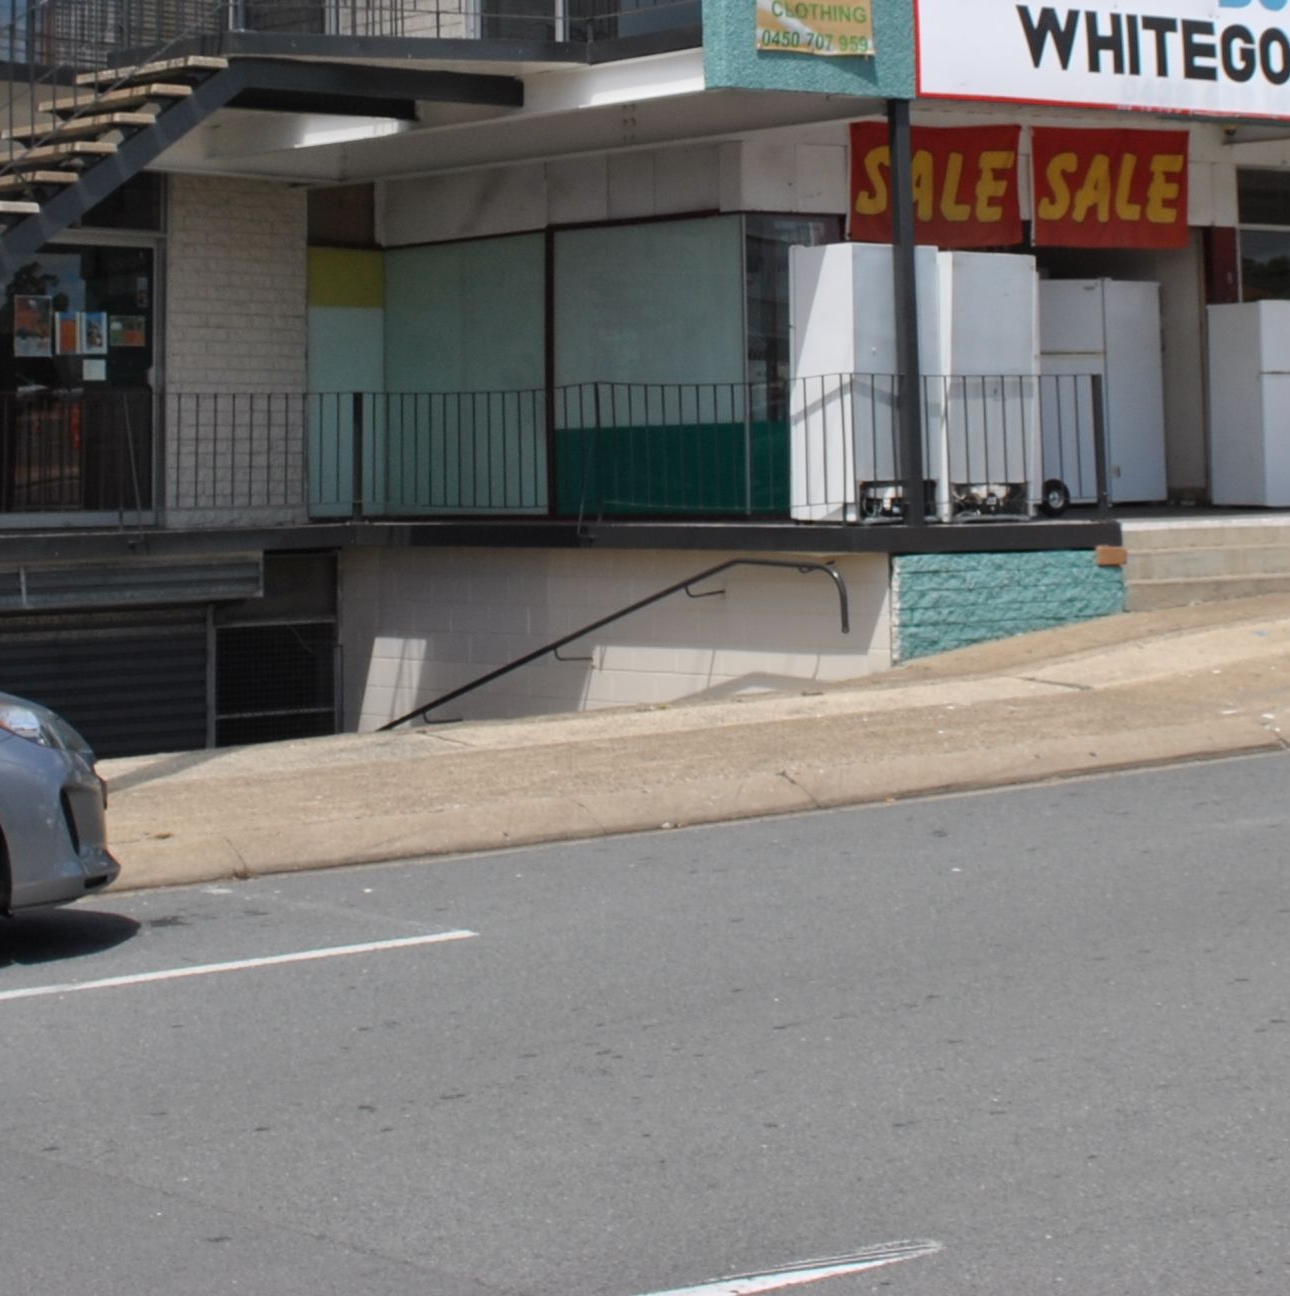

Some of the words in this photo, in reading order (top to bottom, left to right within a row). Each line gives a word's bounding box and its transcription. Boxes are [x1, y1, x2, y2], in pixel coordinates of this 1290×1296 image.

[772, 0, 868, 24] CLOTHING
[761, 29, 800, 48] 0450
[806, 31, 834, 51] 707
[838, 35, 869, 52] 959
[855, 145, 1014, 222] SALE
[1038, 152, 1184, 223] SALE
